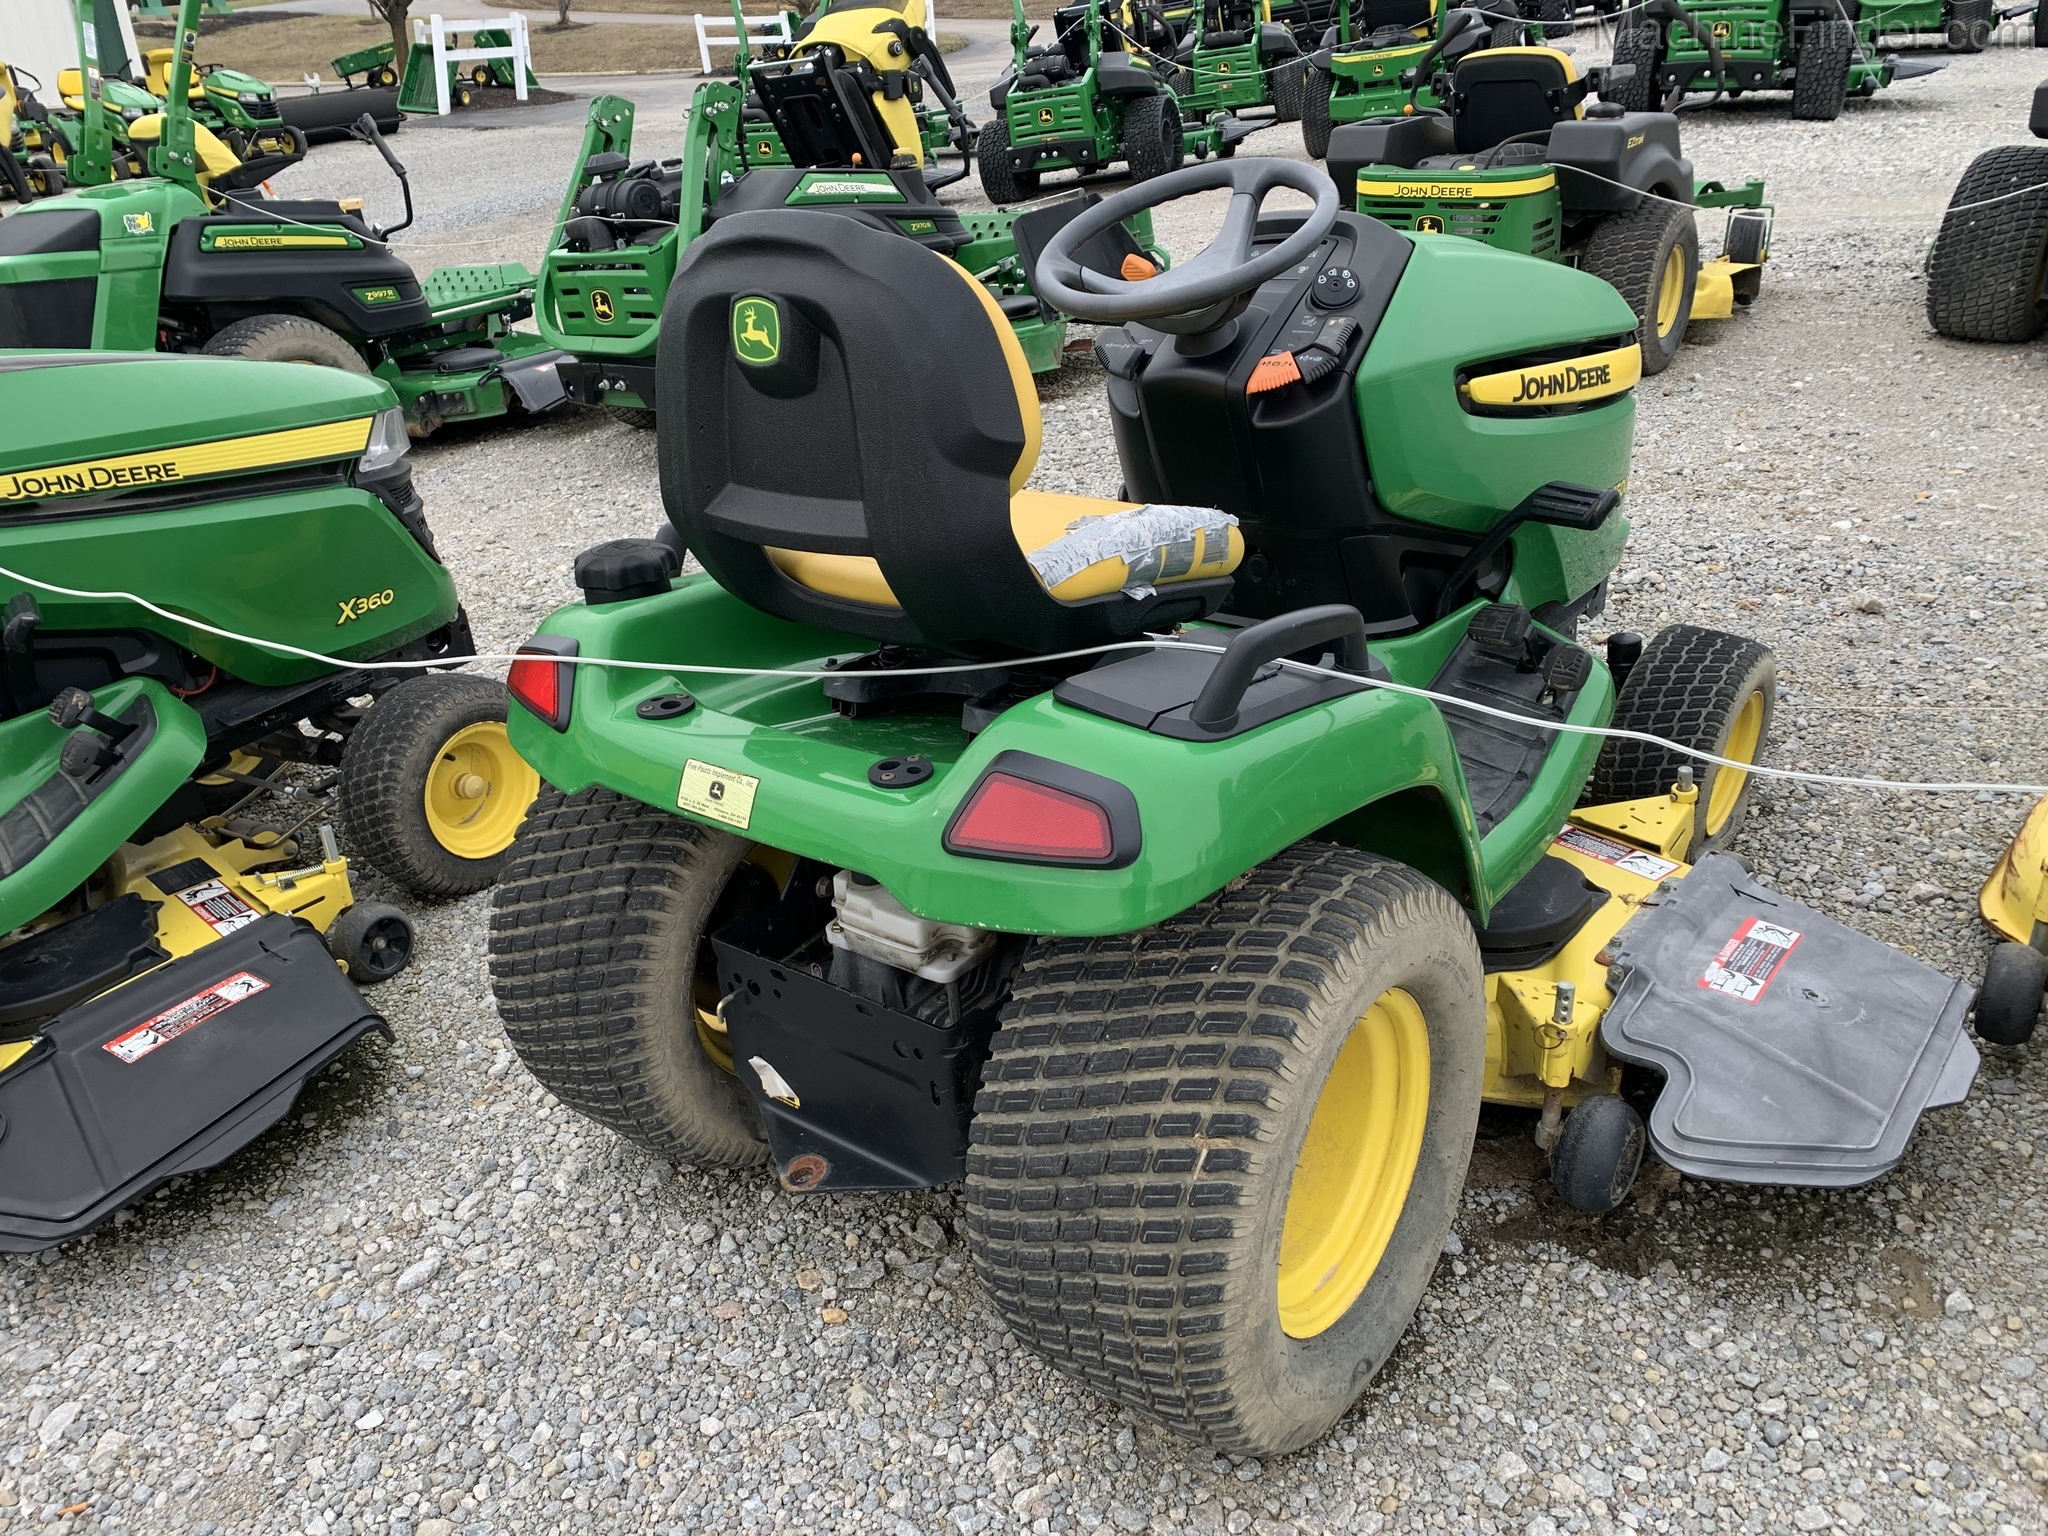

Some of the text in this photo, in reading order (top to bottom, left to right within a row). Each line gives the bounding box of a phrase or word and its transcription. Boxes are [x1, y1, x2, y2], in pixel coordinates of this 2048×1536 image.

[815, 183, 867, 193] JOHN DEERE
[1394, 184, 1473, 197] JOHN DEERE
[222, 236, 283, 247] JOHN DEERE
[1512, 364, 1611, 403] JOHN DEERE
[6, 462, 181, 498] JOHN DEERE
[336, 588, 395, 625] X360
[687, 761, 697, 771] Five
[697, 764, 712, 775] Points
[711, 768, 737, 783] Implement
[1559, 841, 1598, 857] DANGER
